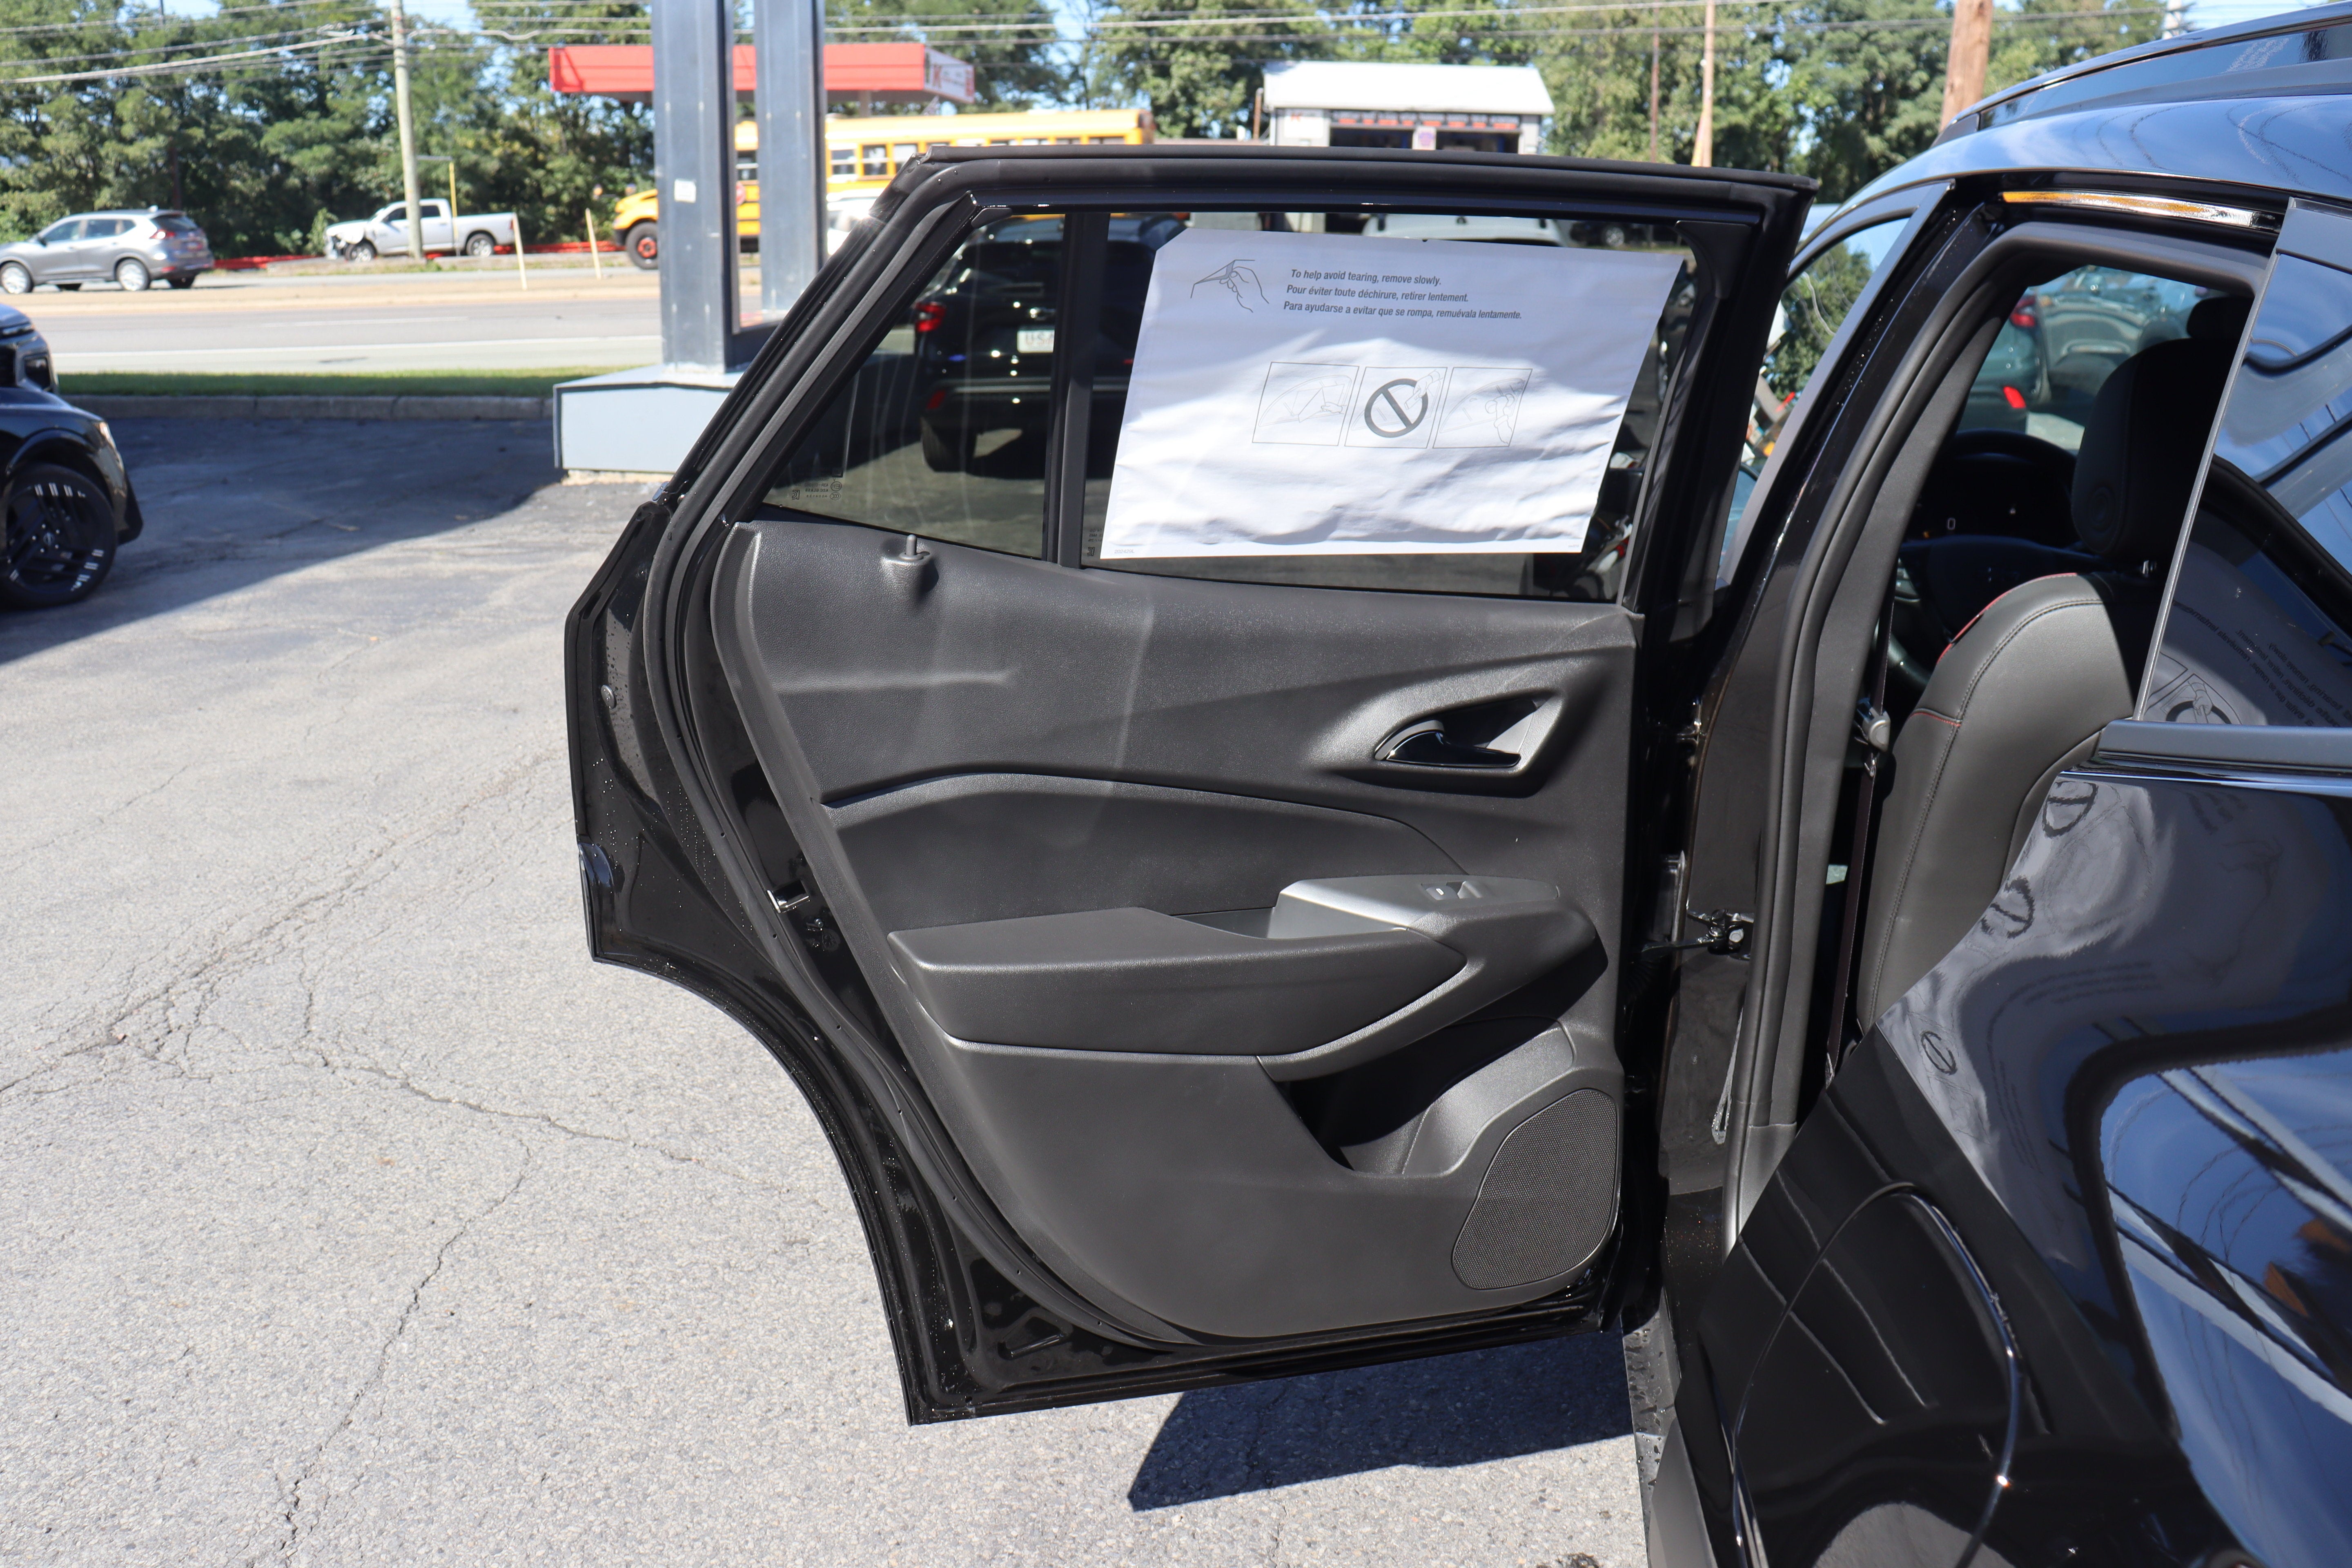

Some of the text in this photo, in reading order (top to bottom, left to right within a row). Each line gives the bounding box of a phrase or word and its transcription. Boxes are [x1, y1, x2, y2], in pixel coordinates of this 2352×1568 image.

[1292, 269, 1441, 287] To help avoid tearing, remove slowly.
[1286, 284, 1469, 302] Pour éviter toute déchirure, retirer lentement.
[1283, 301, 1303, 311] Para
[1305, 303, 1343, 313] ayudarse
[1353, 306, 1377, 315] evitar
[1378, 308, 1394, 317] que
[1407, 310, 1434, 318] rompa,
[1436, 309, 1477, 318] remuévala
[1478, 310, 1522, 319] lentamente.
